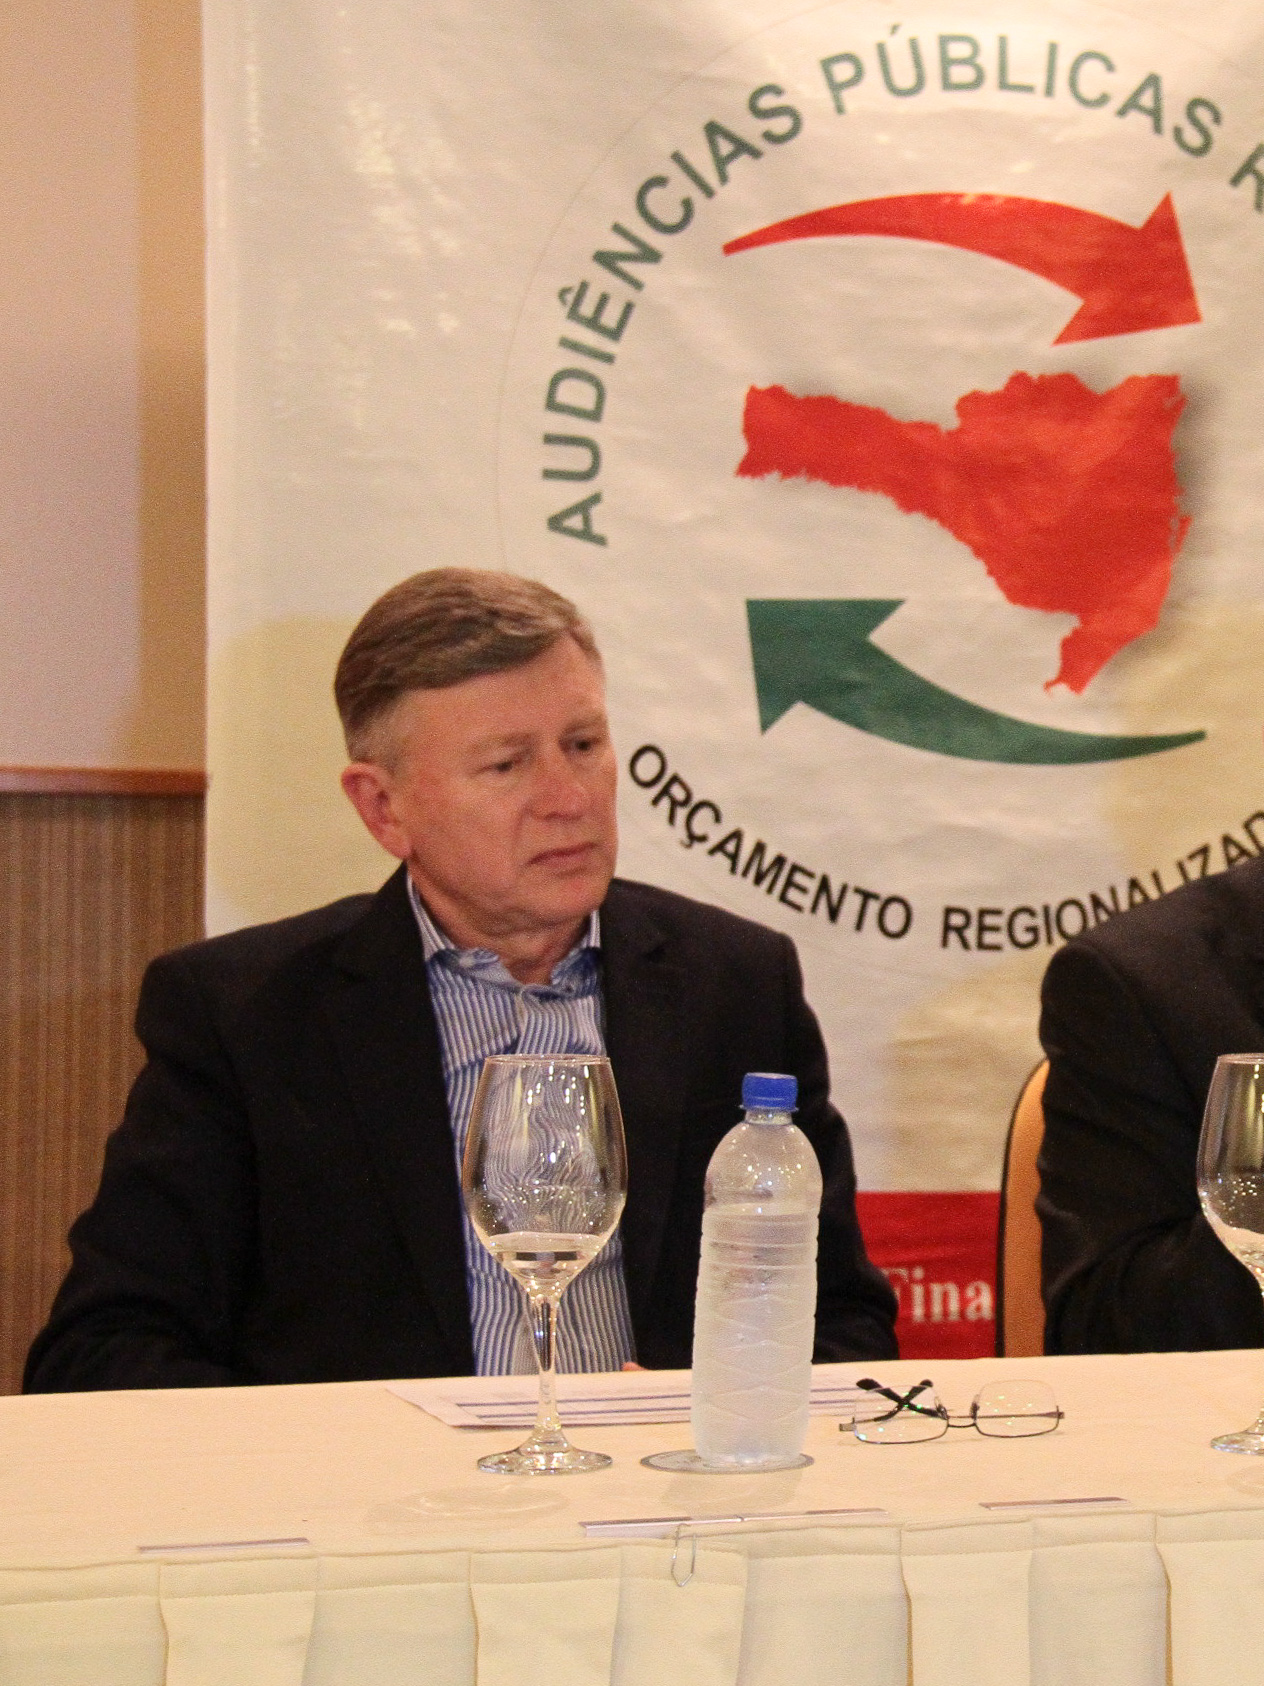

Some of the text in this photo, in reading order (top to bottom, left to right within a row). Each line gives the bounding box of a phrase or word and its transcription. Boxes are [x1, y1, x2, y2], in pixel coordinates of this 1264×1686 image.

[542, 83, 804, 547] AUDIÊNCIAS
[819, 23, 1223, 158] PÚBLICAS
[628, 744, 913, 940] ORÇAMENTO
